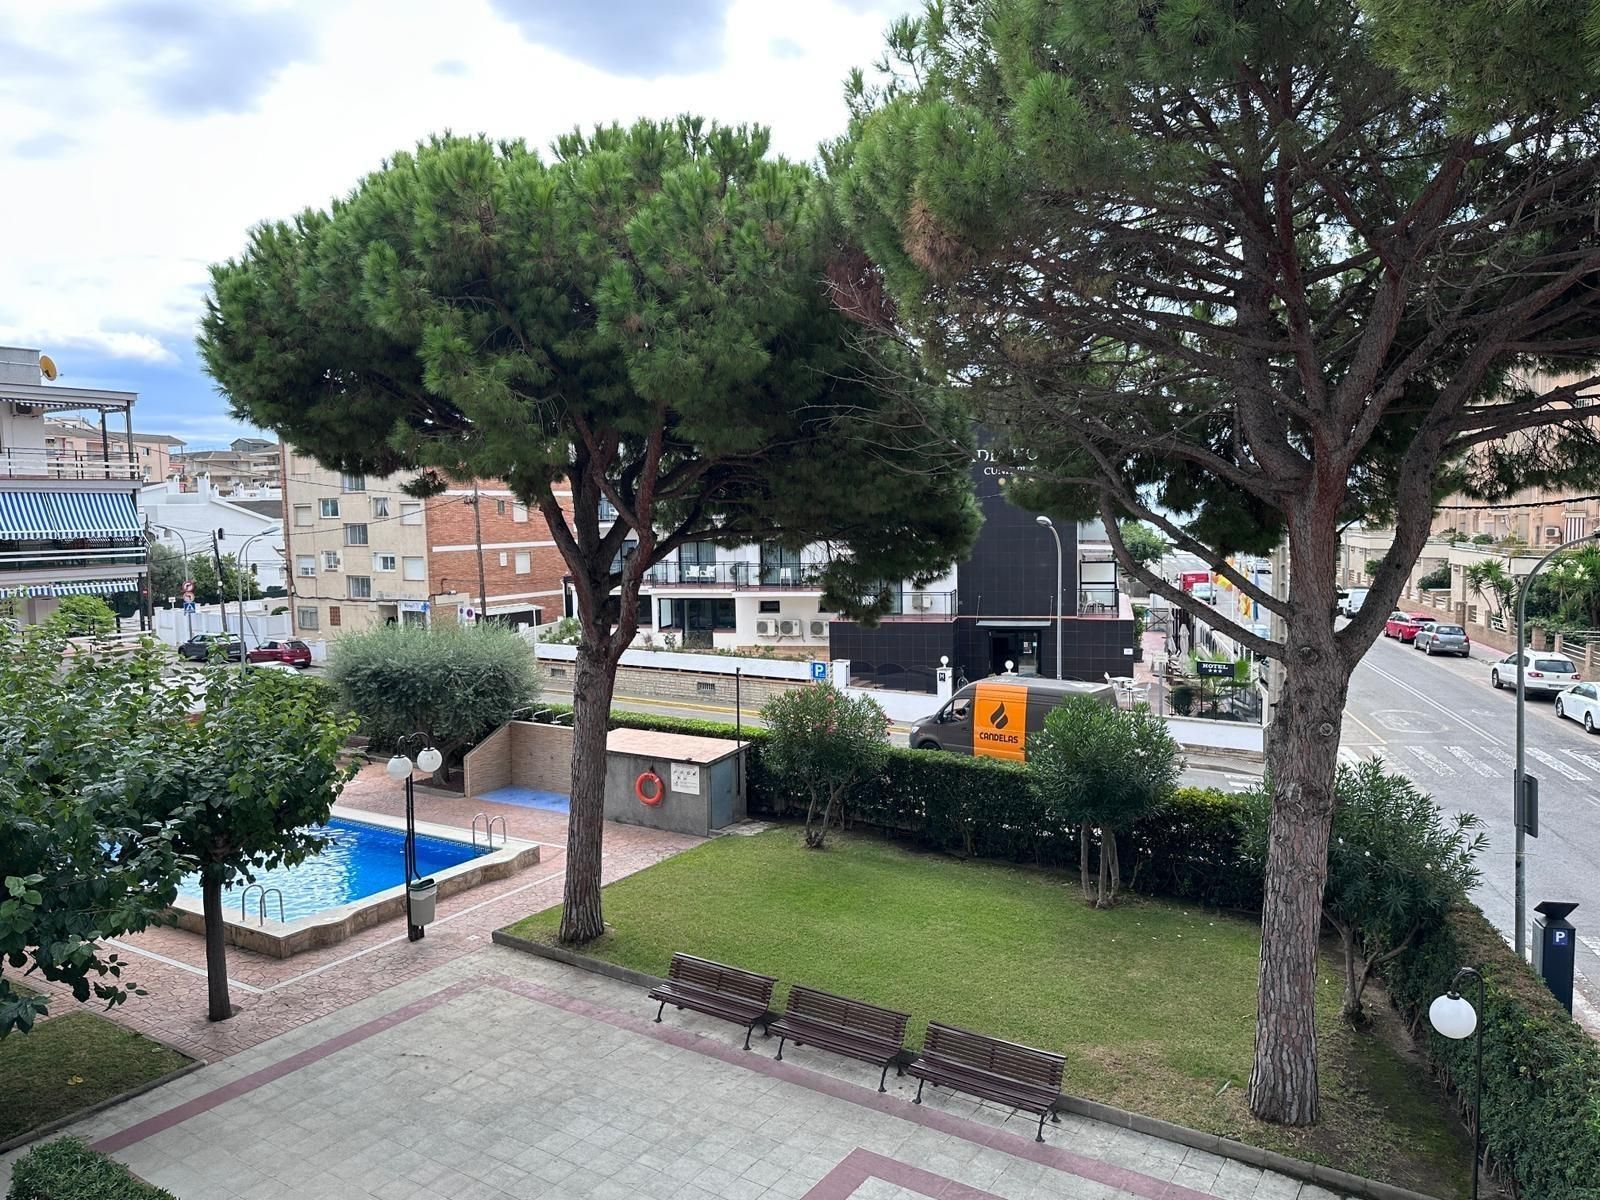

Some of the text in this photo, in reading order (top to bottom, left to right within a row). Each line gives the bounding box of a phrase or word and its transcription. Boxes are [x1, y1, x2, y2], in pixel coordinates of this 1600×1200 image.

[815, 664, 824, 677] P
[979, 732, 1019, 744] CANDELAS
[1555, 931, 1566, 943] P
